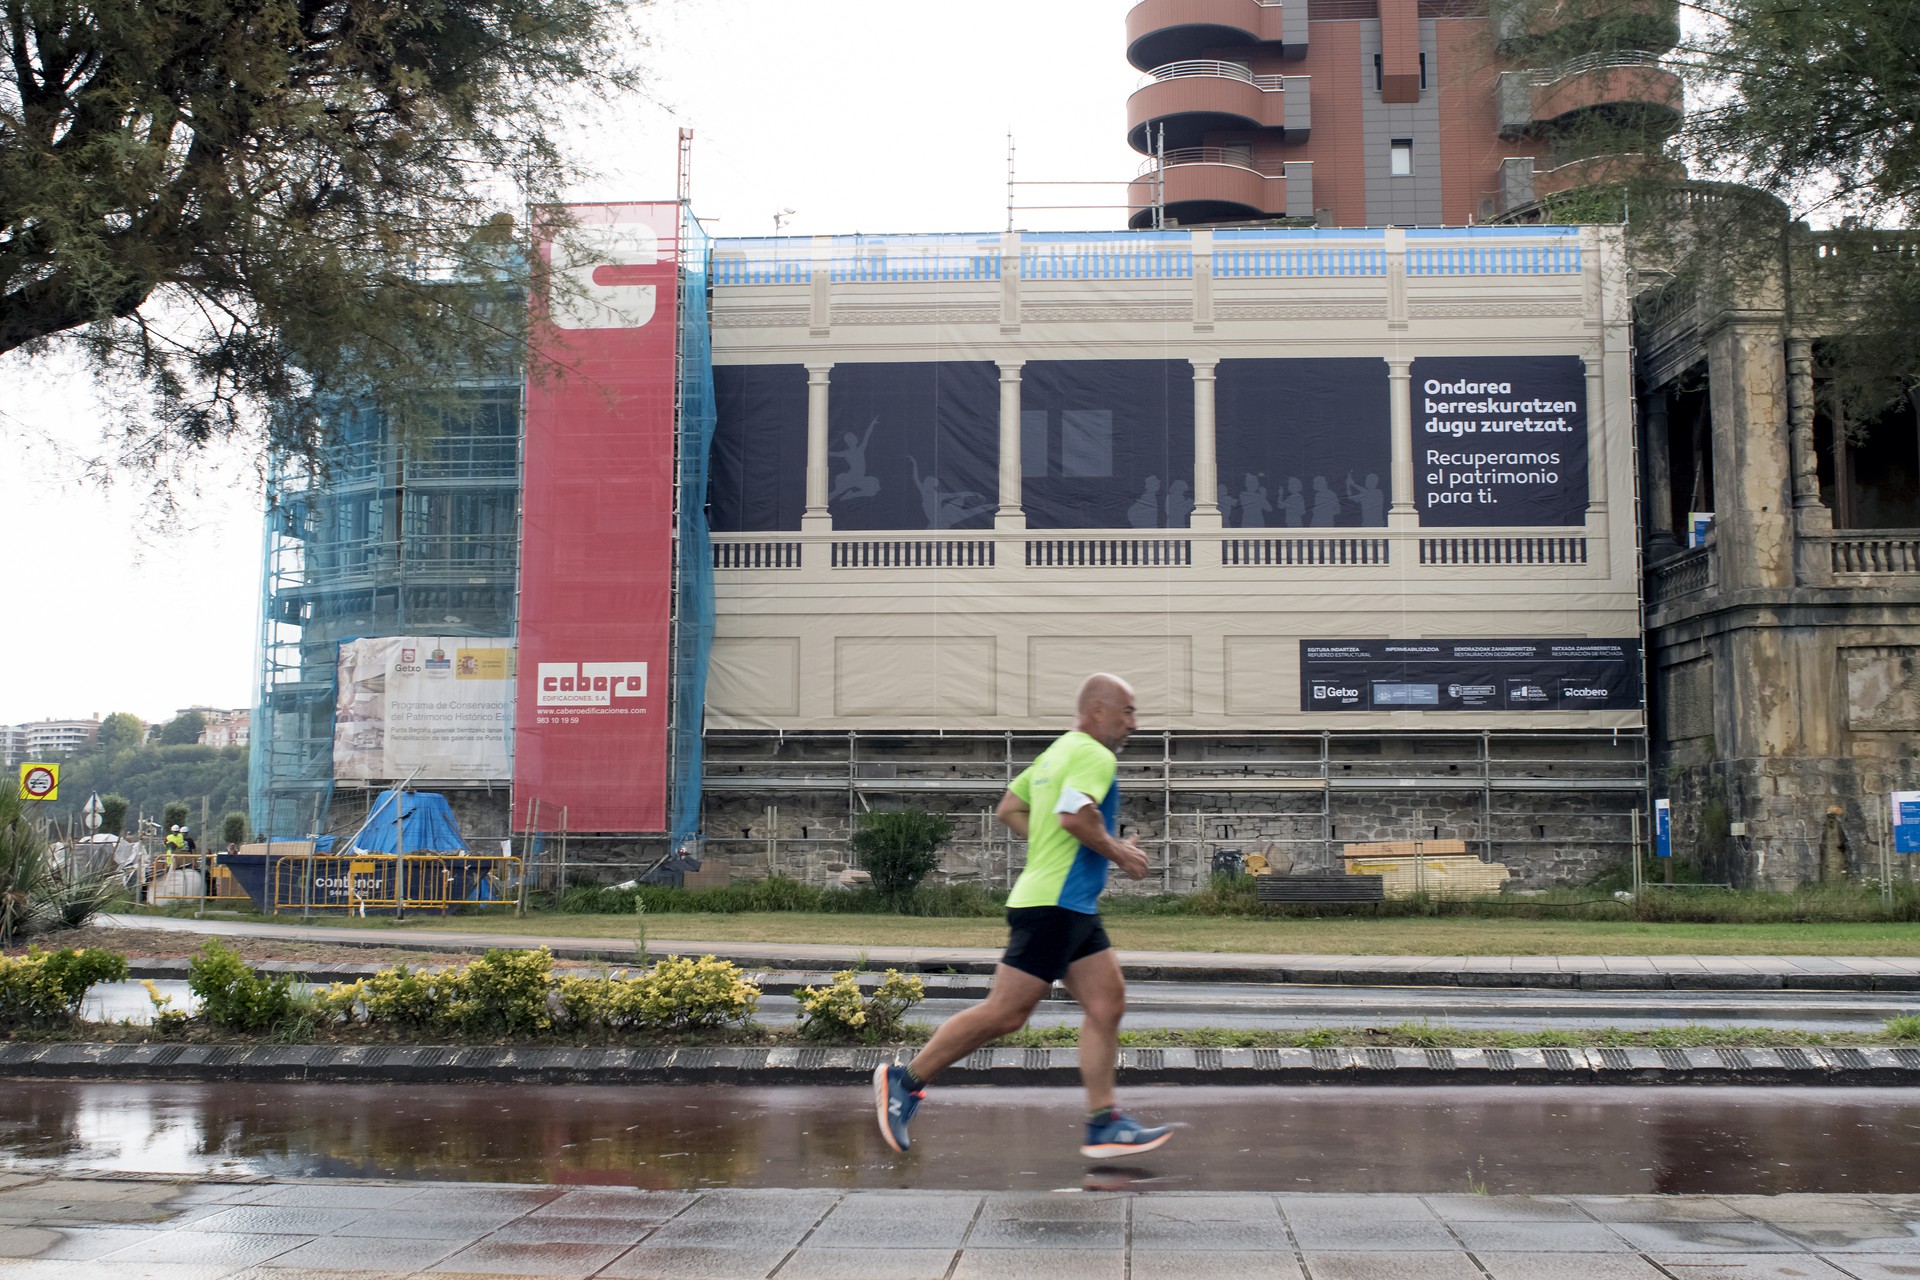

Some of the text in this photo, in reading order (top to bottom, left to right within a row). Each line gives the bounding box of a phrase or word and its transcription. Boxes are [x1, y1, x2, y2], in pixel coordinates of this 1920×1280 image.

[1424, 379, 1511, 394] Ondarea
[1424, 398, 1577, 413] berreskuratzen
[1425, 417, 1573, 437] dugu zuretzat.
[1426, 450, 1560, 469] Recuperamos
[1427, 468, 1558, 488] el patrimonio
[1428, 488, 1498, 508] para ti.
[395, 664, 421, 672] Getxo
[1327, 687, 1359, 697] Getxo
[1573, 687, 1608, 697] cabero
[391, 701, 432, 711] Programa
[436, 701, 447, 710] de
[536, 707, 647, 715] www.caberoedificaciones.com
[391, 712, 404, 721] del
[406, 712, 453, 721] Patrimonio
[455, 711, 493, 721] Histórico
